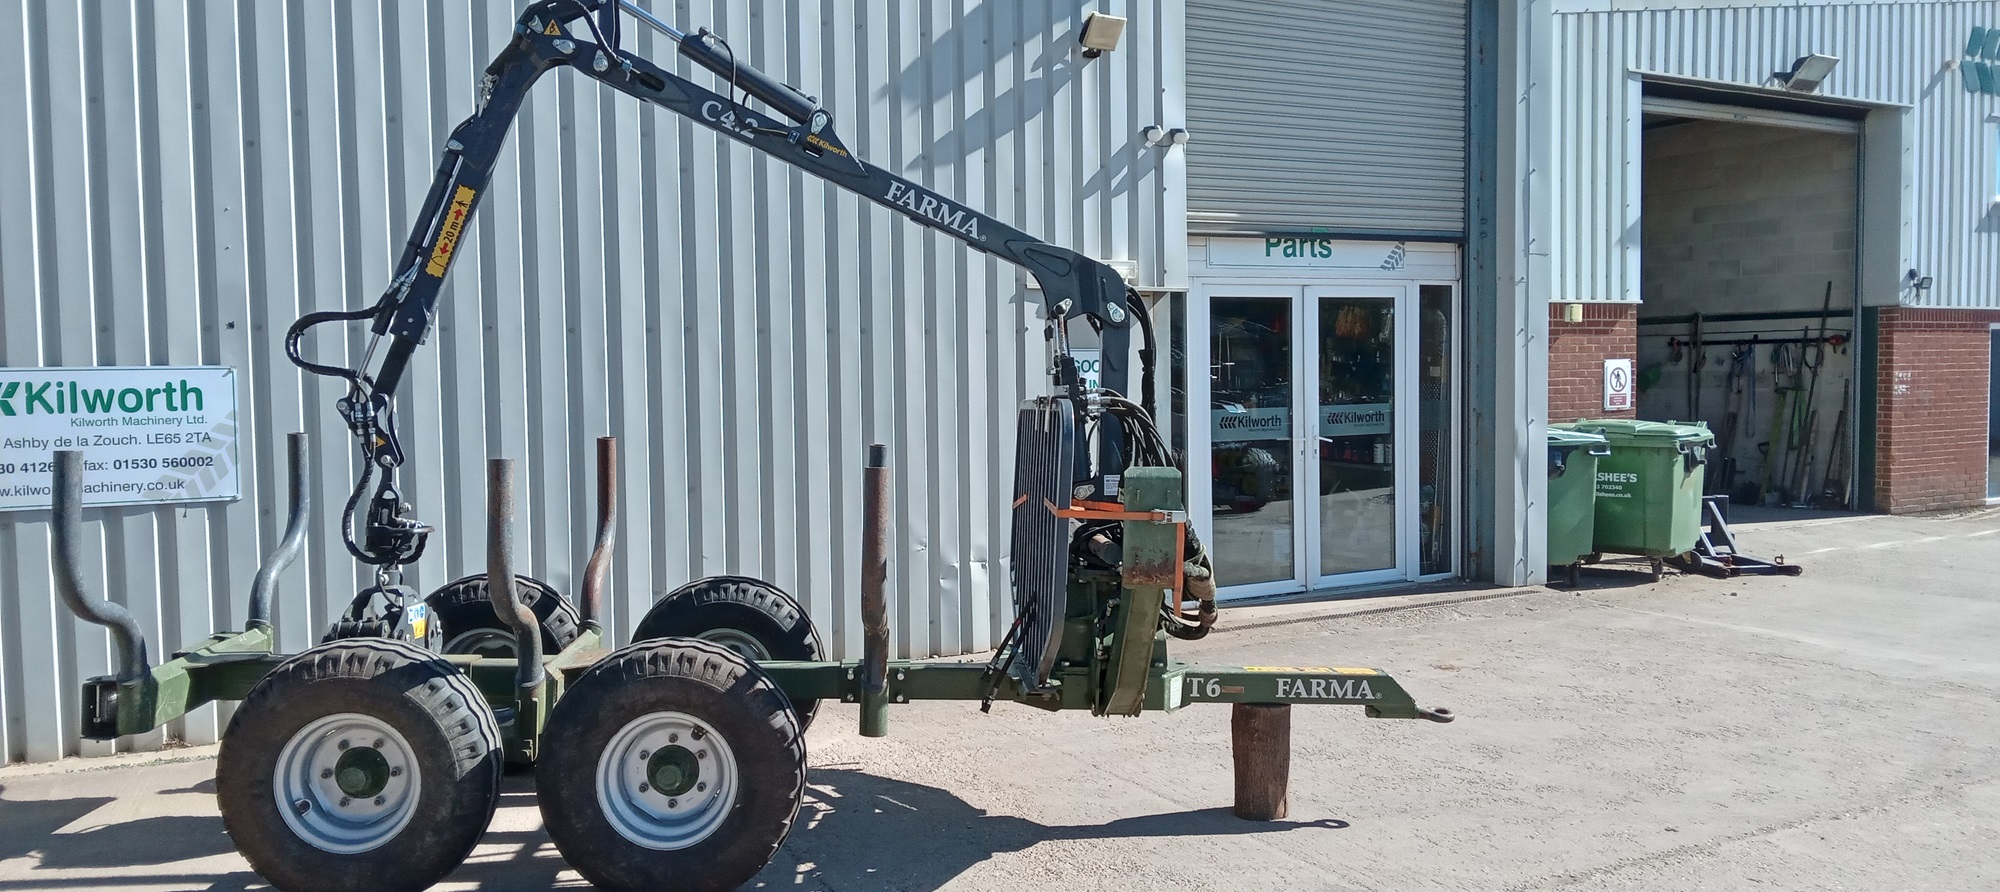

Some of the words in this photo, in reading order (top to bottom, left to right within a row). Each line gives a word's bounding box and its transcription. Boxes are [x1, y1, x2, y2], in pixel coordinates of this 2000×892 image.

[701, 100, 759, 140] C4.2
[818, 139, 848, 158] Kilworth
[443, 230, 455, 243] 20
[450, 221, 459, 231] m
[1265, 238, 1332, 259] Parts
[25, 379, 203, 415] Kilworth
[70, 417, 118, 427] Kilworth
[122, 416, 182, 427] Machinery
[186, 415, 208, 424] Ltd.
[1237, 415, 1281, 428] Kilworth
[1344, 411, 1384, 423] Kilworth
[3, 437, 49, 451] Ashby
[54, 436, 72, 447] de
[76, 436, 89, 446] la
[93, 434, 141, 446] Zouch.
[146, 433, 181, 444] LE65
[185, 432, 212, 443] 2TA
[83, 460, 108, 471] fax:
[113, 458, 157, 470] 01530
[162, 456, 213, 468] 560002
[1597, 472, 1638, 483] SHEE'S
[1187, 677, 1221, 697] T6
